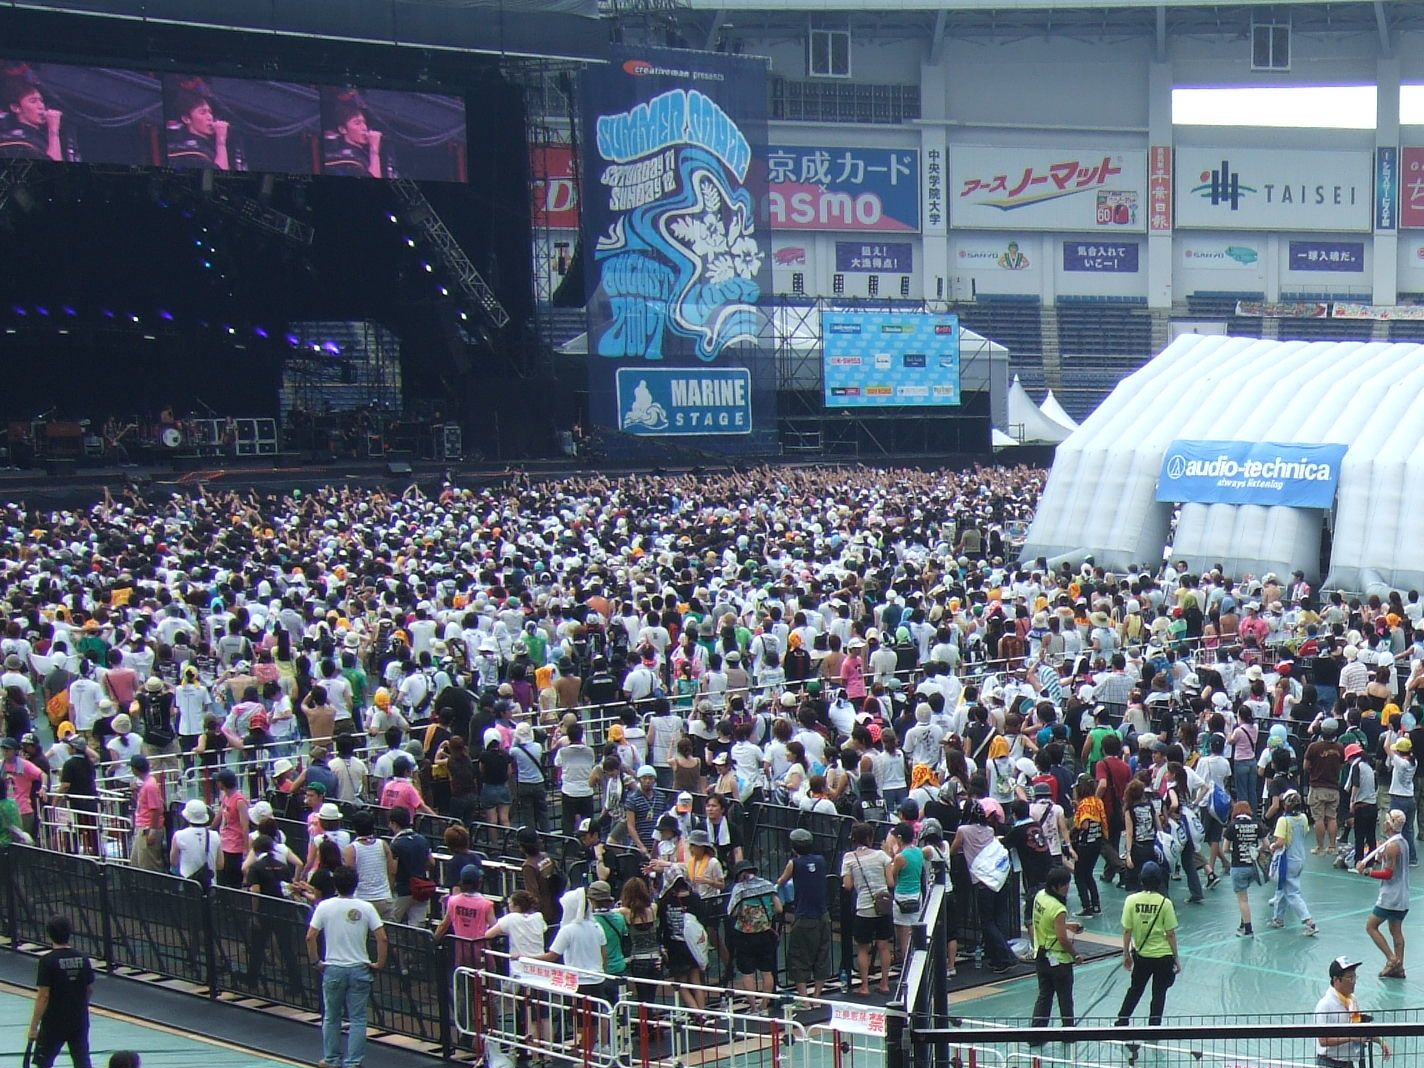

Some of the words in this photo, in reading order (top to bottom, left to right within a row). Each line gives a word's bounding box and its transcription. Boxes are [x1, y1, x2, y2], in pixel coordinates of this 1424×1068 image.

[768, 150, 912, 186] 京成カード
[928, 149, 941, 226] 中央学院大学
[1264, 184, 1356, 206] TAISEI
[671, 379, 745, 407] MARINE
[675, 412, 744, 426] STAGE
[1185, 454, 1331, 481] audio-technica
[1217, 478, 1246, 488] always
[1247, 479, 1284, 490] listening
[1134, 902, 1159, 914] STAFF
